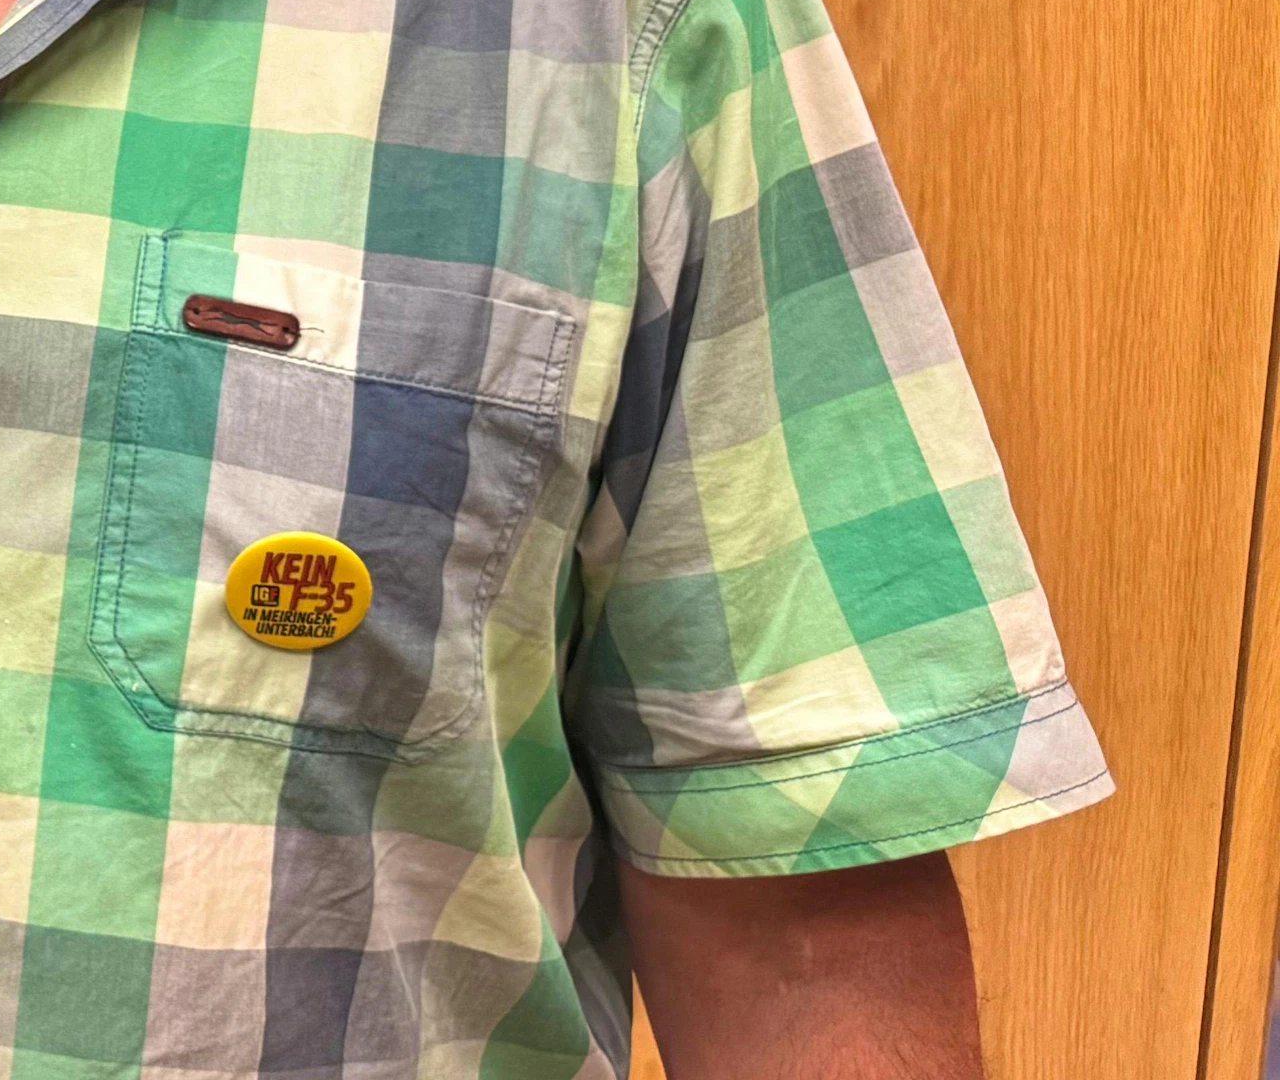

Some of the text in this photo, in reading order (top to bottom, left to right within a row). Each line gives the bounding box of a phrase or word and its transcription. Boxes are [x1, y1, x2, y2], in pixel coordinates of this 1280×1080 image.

[260, 551, 337, 585] KEIN
[289, 581, 355, 614] F-35
[243, 608, 258, 620] IN
[256, 622, 336, 638] UNTERBACH!
